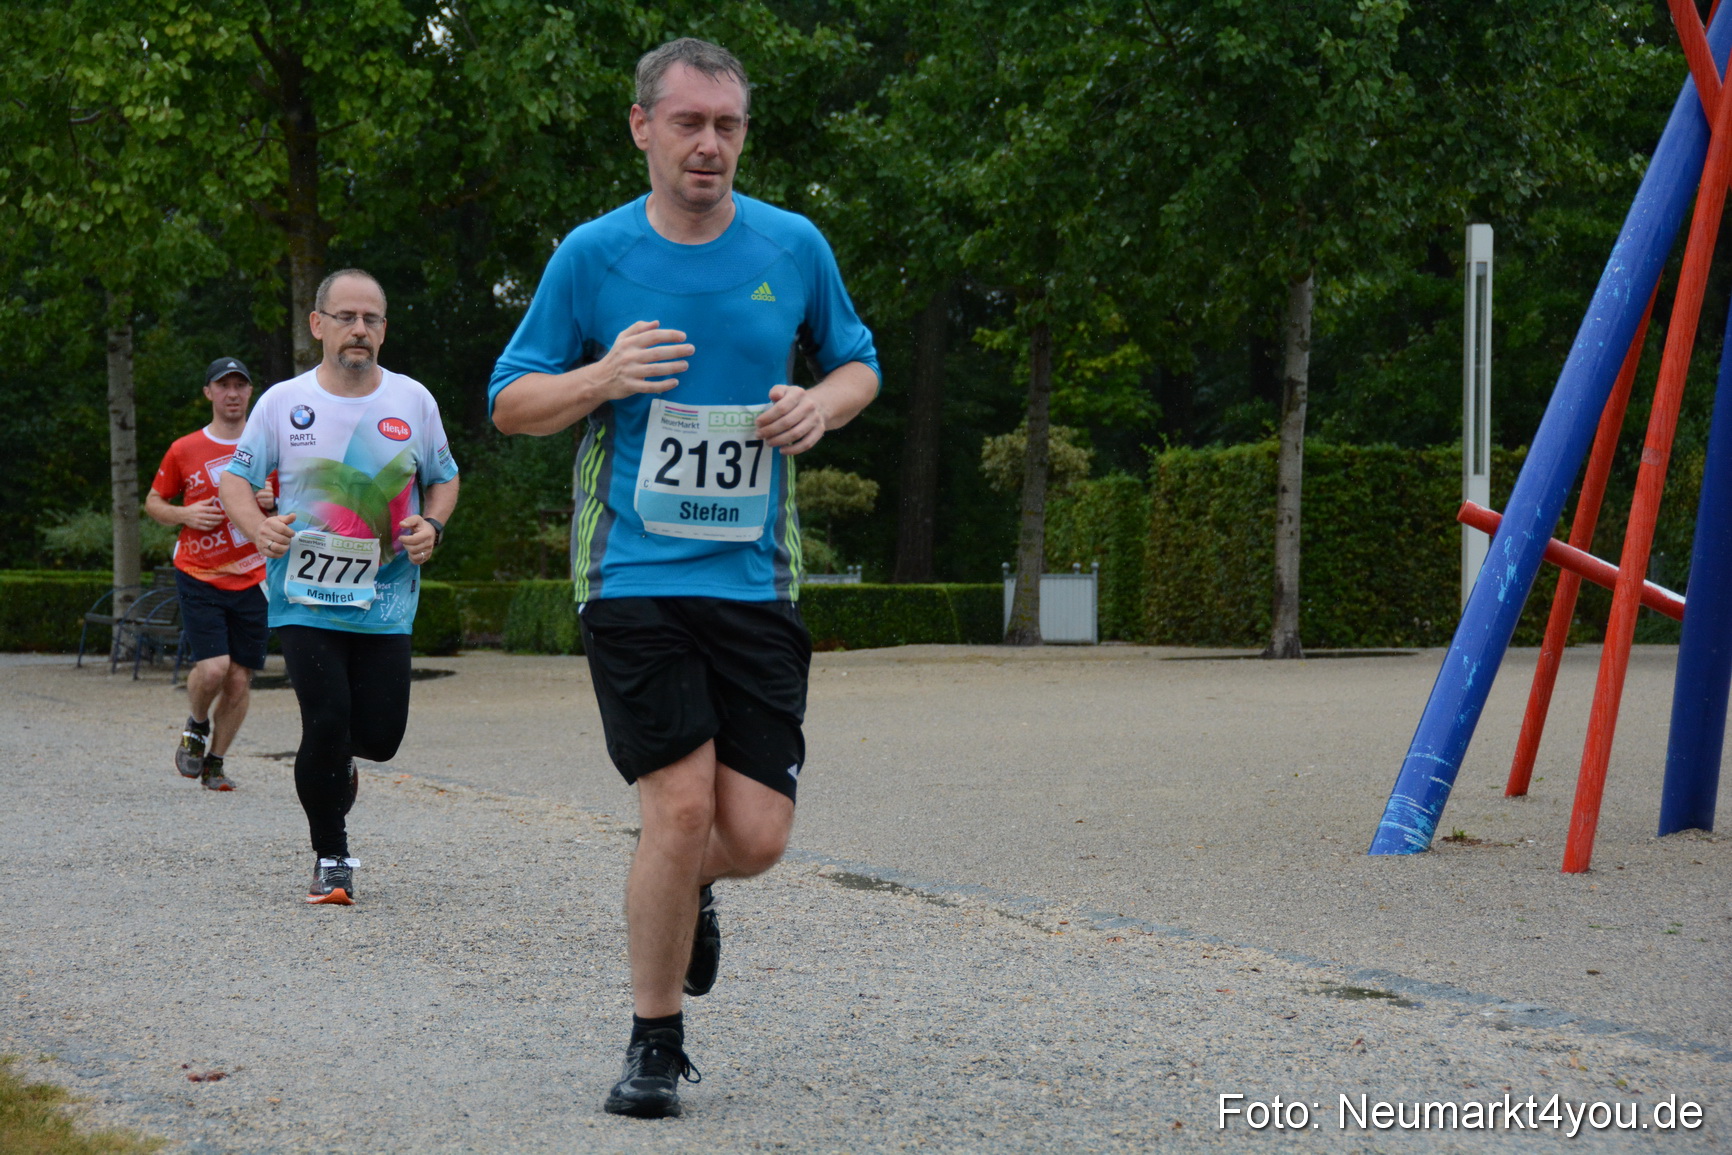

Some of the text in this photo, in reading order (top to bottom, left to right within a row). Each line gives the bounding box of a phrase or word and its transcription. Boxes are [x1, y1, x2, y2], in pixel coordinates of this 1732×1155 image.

[751, 294, 776, 302] adidas
[660, 416, 700, 429] NeuerMarkt
[708, 411, 764, 428] BOC
[383, 422, 409, 435] Hervis
[289, 433, 316, 442] PARTL
[290, 440, 316, 448] Neumarkt
[654, 437, 764, 489] 2137
[679, 501, 740, 522] Stefan
[332, 537, 374, 552] BOCK
[297, 549, 372, 584] 2777
[307, 588, 354, 603] Manfred
